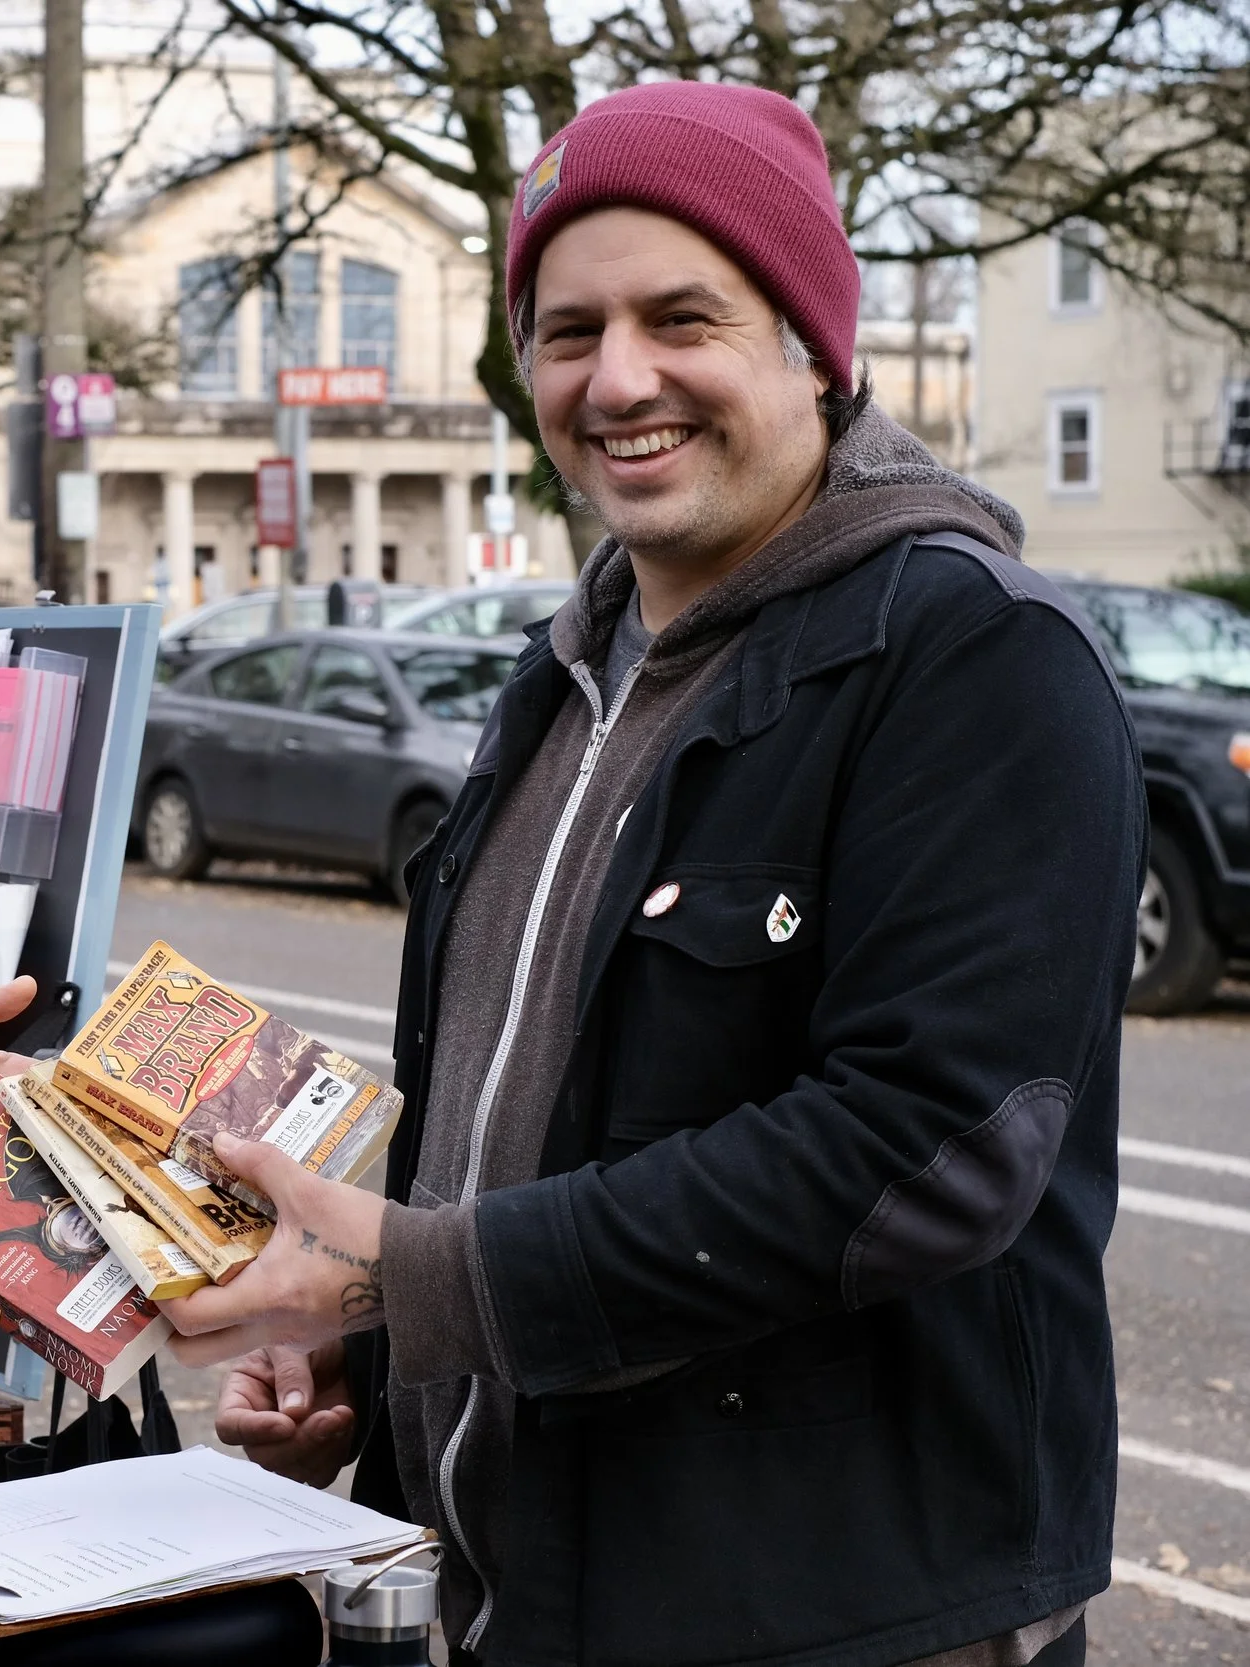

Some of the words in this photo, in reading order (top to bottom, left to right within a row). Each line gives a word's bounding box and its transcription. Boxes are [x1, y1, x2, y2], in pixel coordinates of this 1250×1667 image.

[76, 1029, 100, 1056] FIRST
[97, 1010, 118, 1033] TIME
[113, 999, 126, 1014] IN
[123, 950, 167, 1001] PAPERBACK!
[109, 985, 192, 1064] MAX
[126, 985, 256, 1113] BRAND
[86, 1084, 116, 1109] MAX
[117, 1103, 164, 1137] BRAND
[286, 1109, 312, 1134] BOOKS
[53, 1101, 78, 1130] Max
[76, 1123, 106, 1157] Brand
[107, 1156, 132, 1182] SOUTH
[132, 1180, 144, 1193] OF
[49, 1152, 68, 1178] KILLOE
[68, 1178, 83, 1197] LOUIS
[223, 1222, 255, 1239] SOUTH
[254, 1219, 268, 1229] OF
[20, 1267, 39, 1286] KING
[67, 1288, 98, 1320] STREET
[92, 1263, 122, 1291] BOOKS
[100, 1290, 147, 1338] NAOM
[45, 1346, 96, 1393] NOVIK
[47, 1332, 98, 1377] NAOMI
